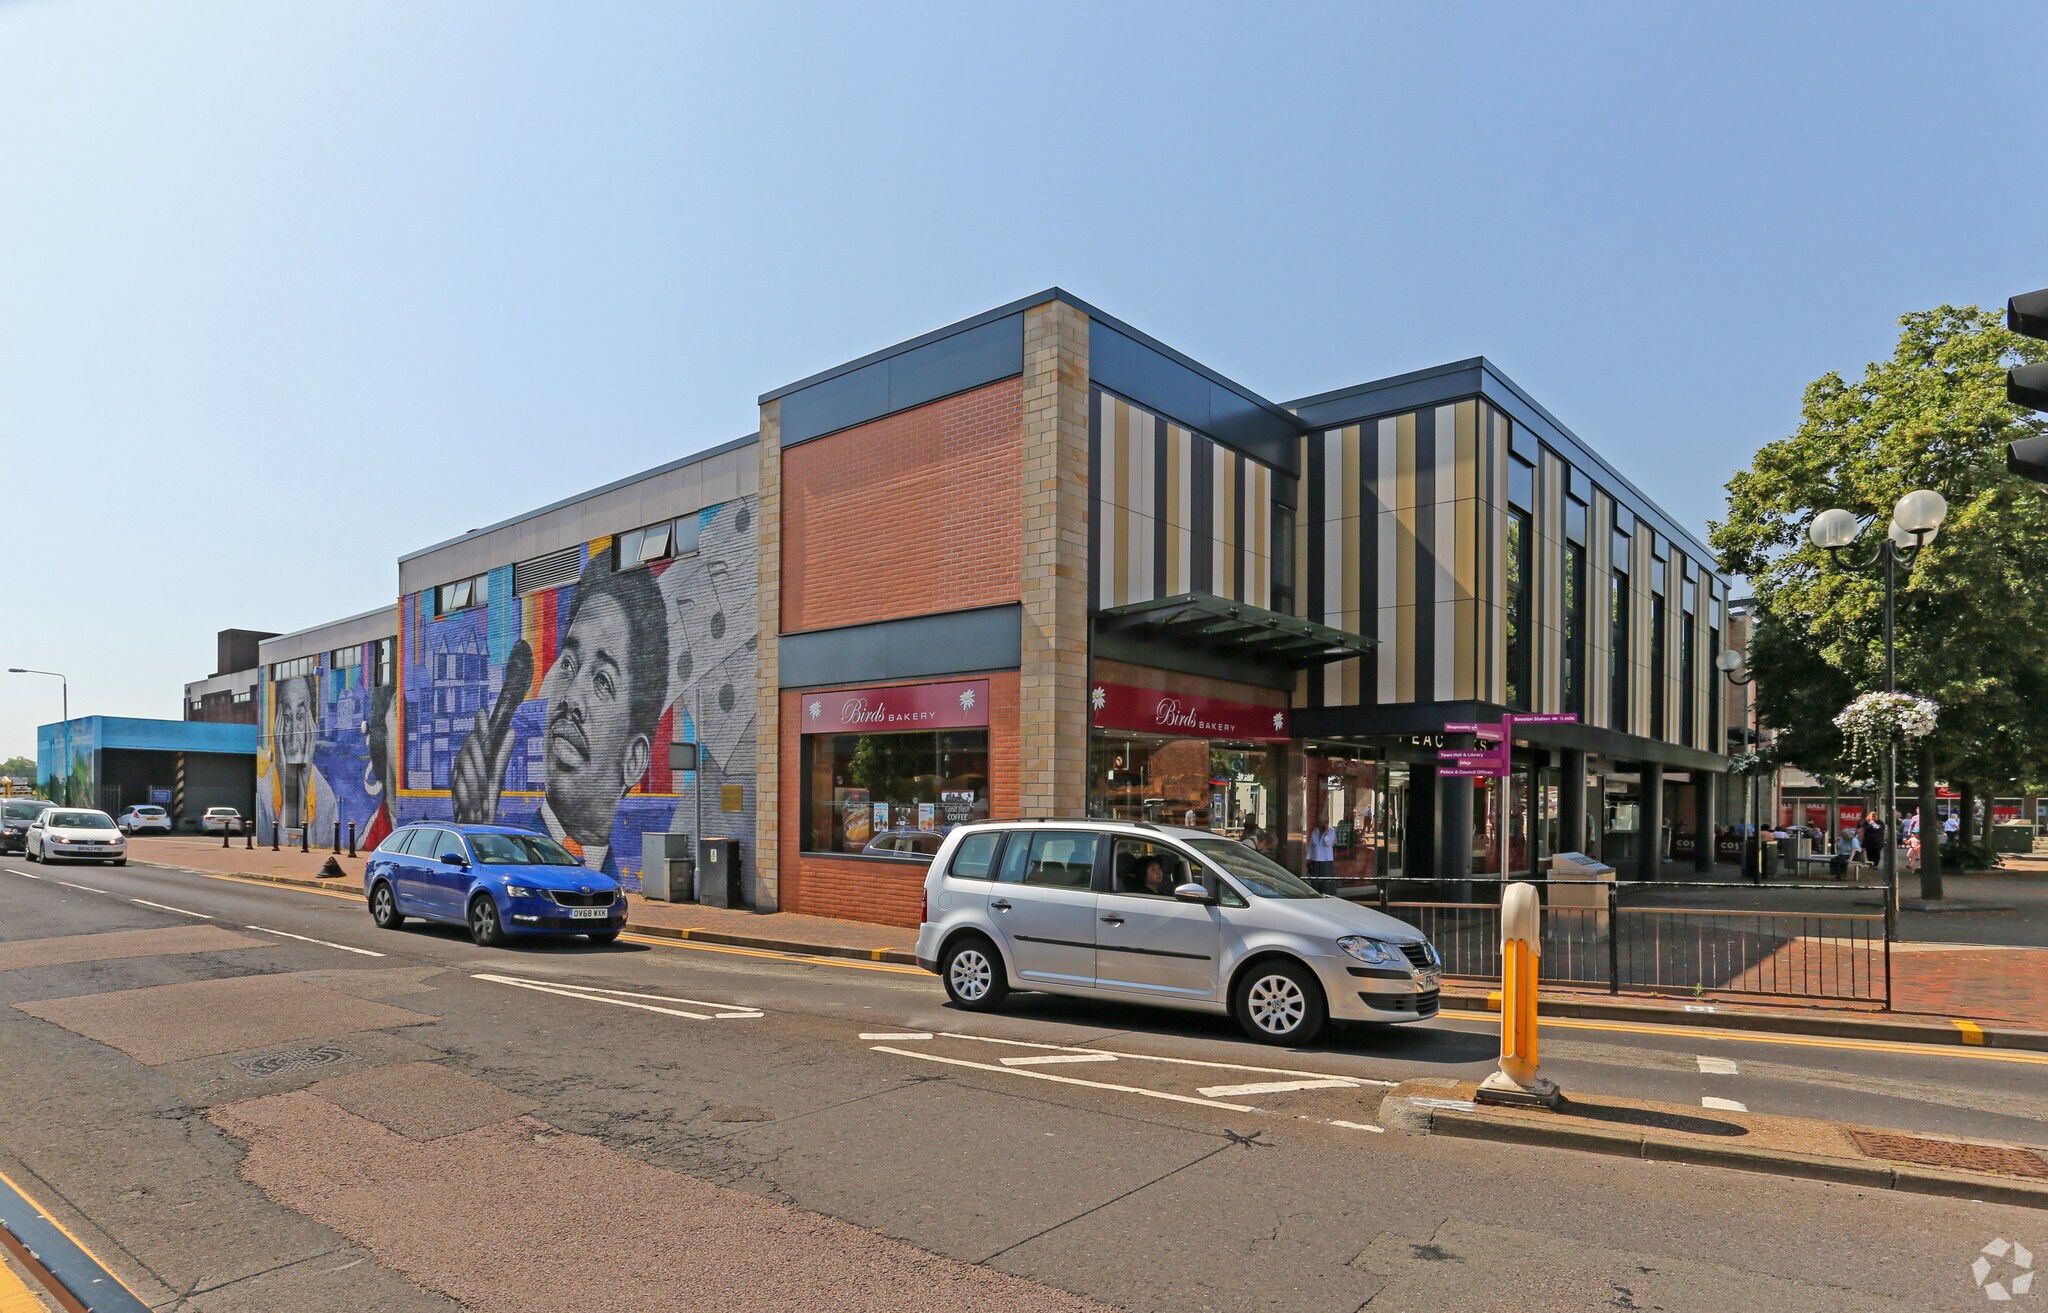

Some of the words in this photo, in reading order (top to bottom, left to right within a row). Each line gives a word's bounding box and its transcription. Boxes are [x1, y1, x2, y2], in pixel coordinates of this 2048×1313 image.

[841, 698, 885, 724] Birds
[888, 712, 936, 722] BAKERY
[1156, 698, 1197, 728] Birds
[1199, 721, 1236, 732] BAKERY
[947, 813, 968, 821] COFFEE
[1676, 840, 1695, 848] COS
[1720, 842, 1743, 850] COS
[573, 909, 592, 917] OV68
[593, 909, 606, 917] WXK
